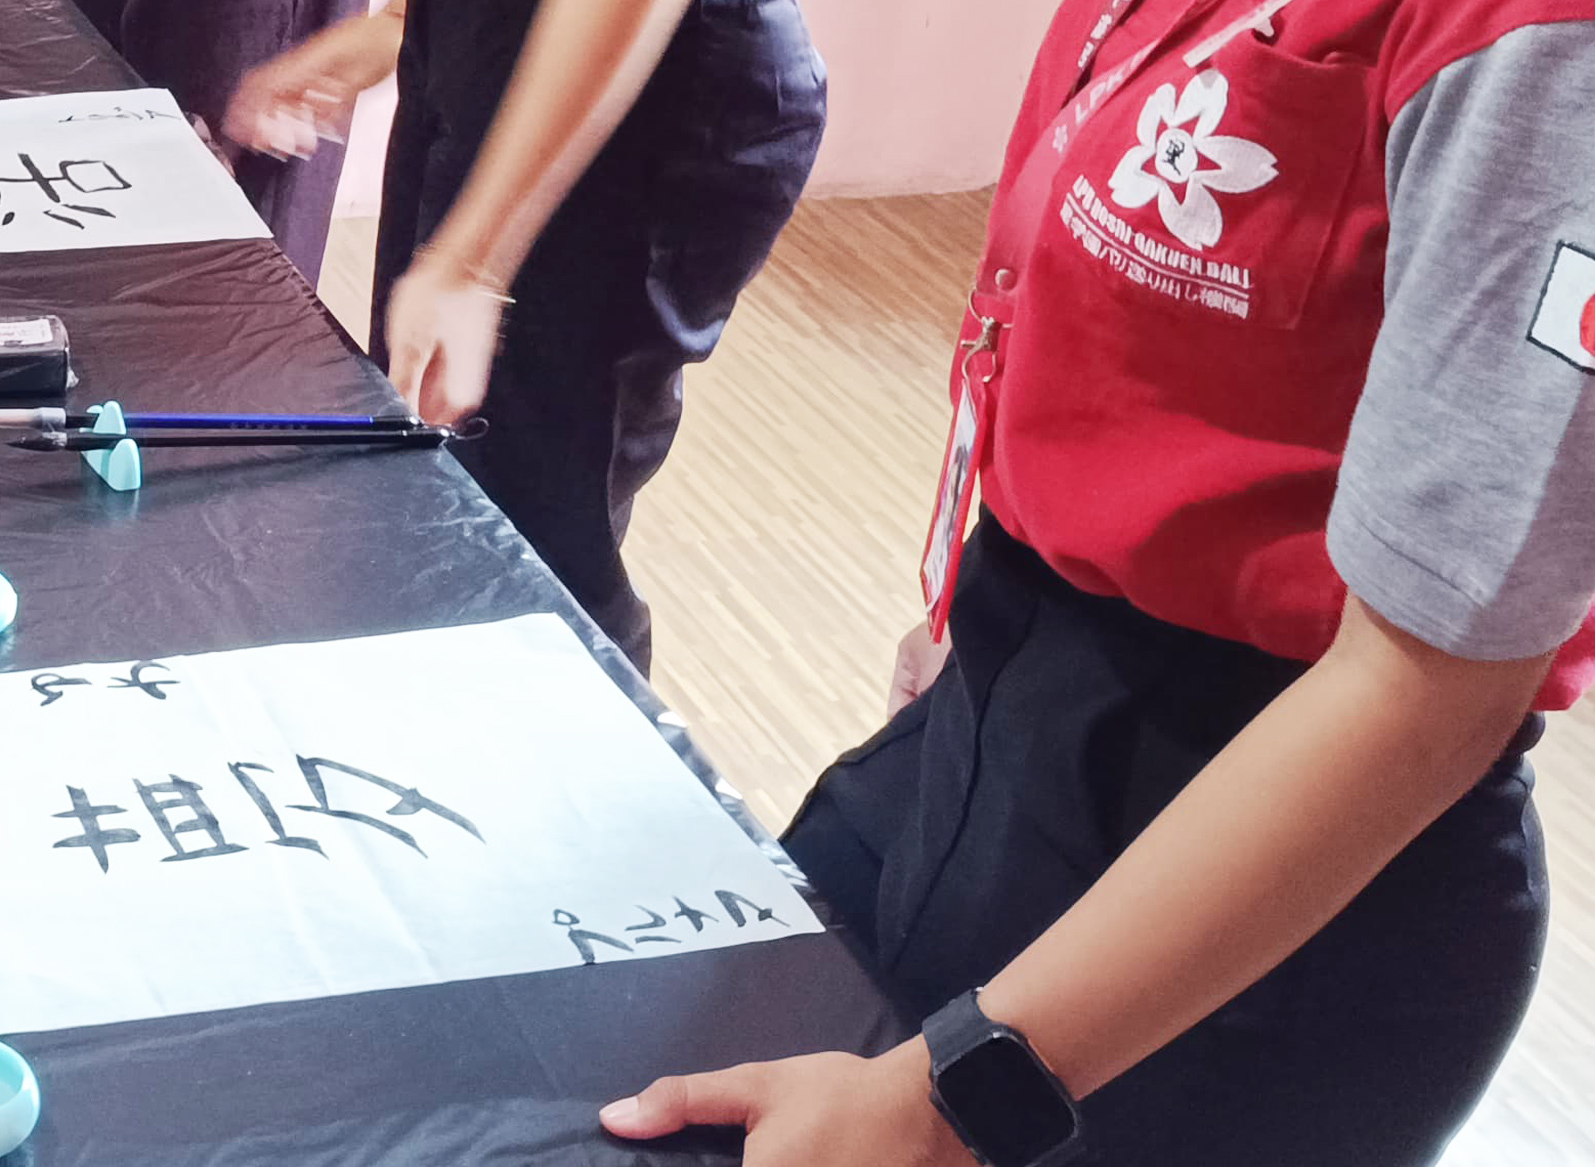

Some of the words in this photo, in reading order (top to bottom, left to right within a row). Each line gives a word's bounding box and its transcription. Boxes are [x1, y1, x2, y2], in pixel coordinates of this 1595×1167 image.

[1134, 232, 1202, 276] GAKUEN
[1207, 261, 1251, 289] BALI
[52, 753, 487, 874] 夢
